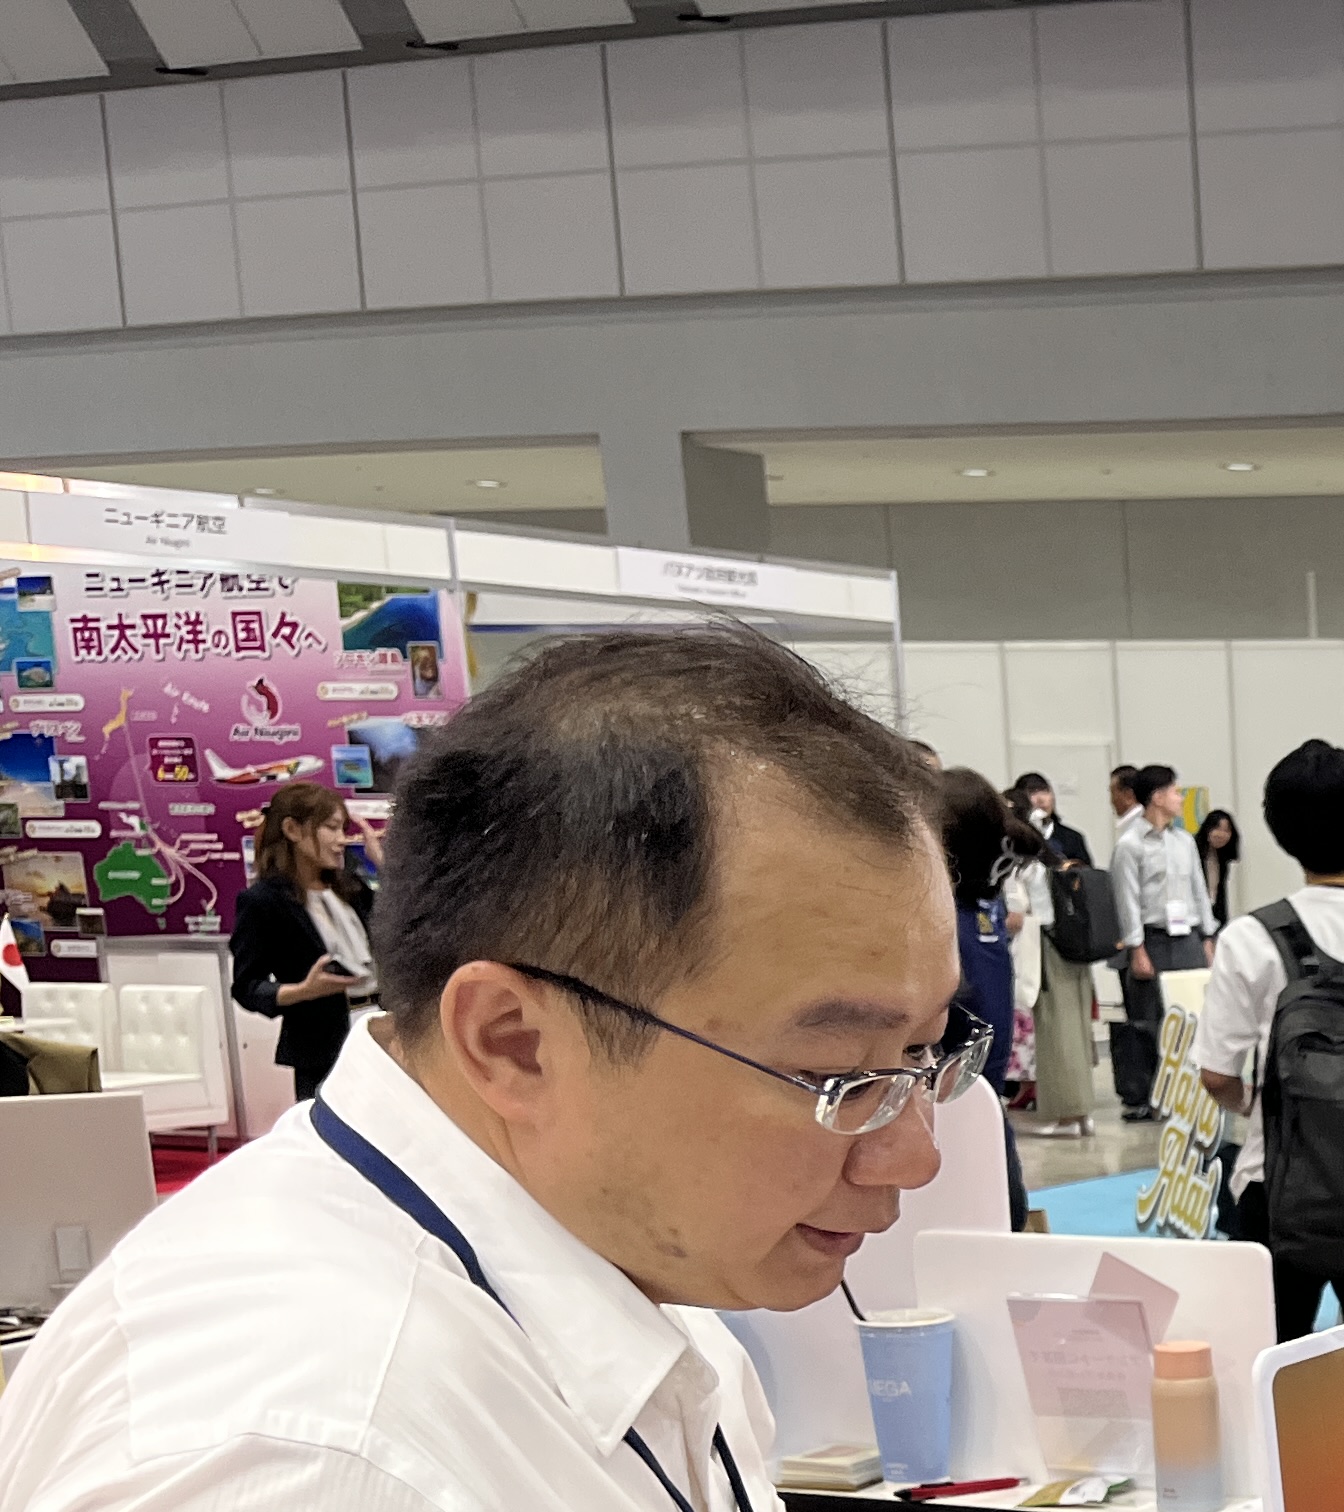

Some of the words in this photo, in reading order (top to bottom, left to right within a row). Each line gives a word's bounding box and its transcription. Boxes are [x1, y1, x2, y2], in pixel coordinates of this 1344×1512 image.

[69, 608, 327, 660] 南太平洋の国々へ
